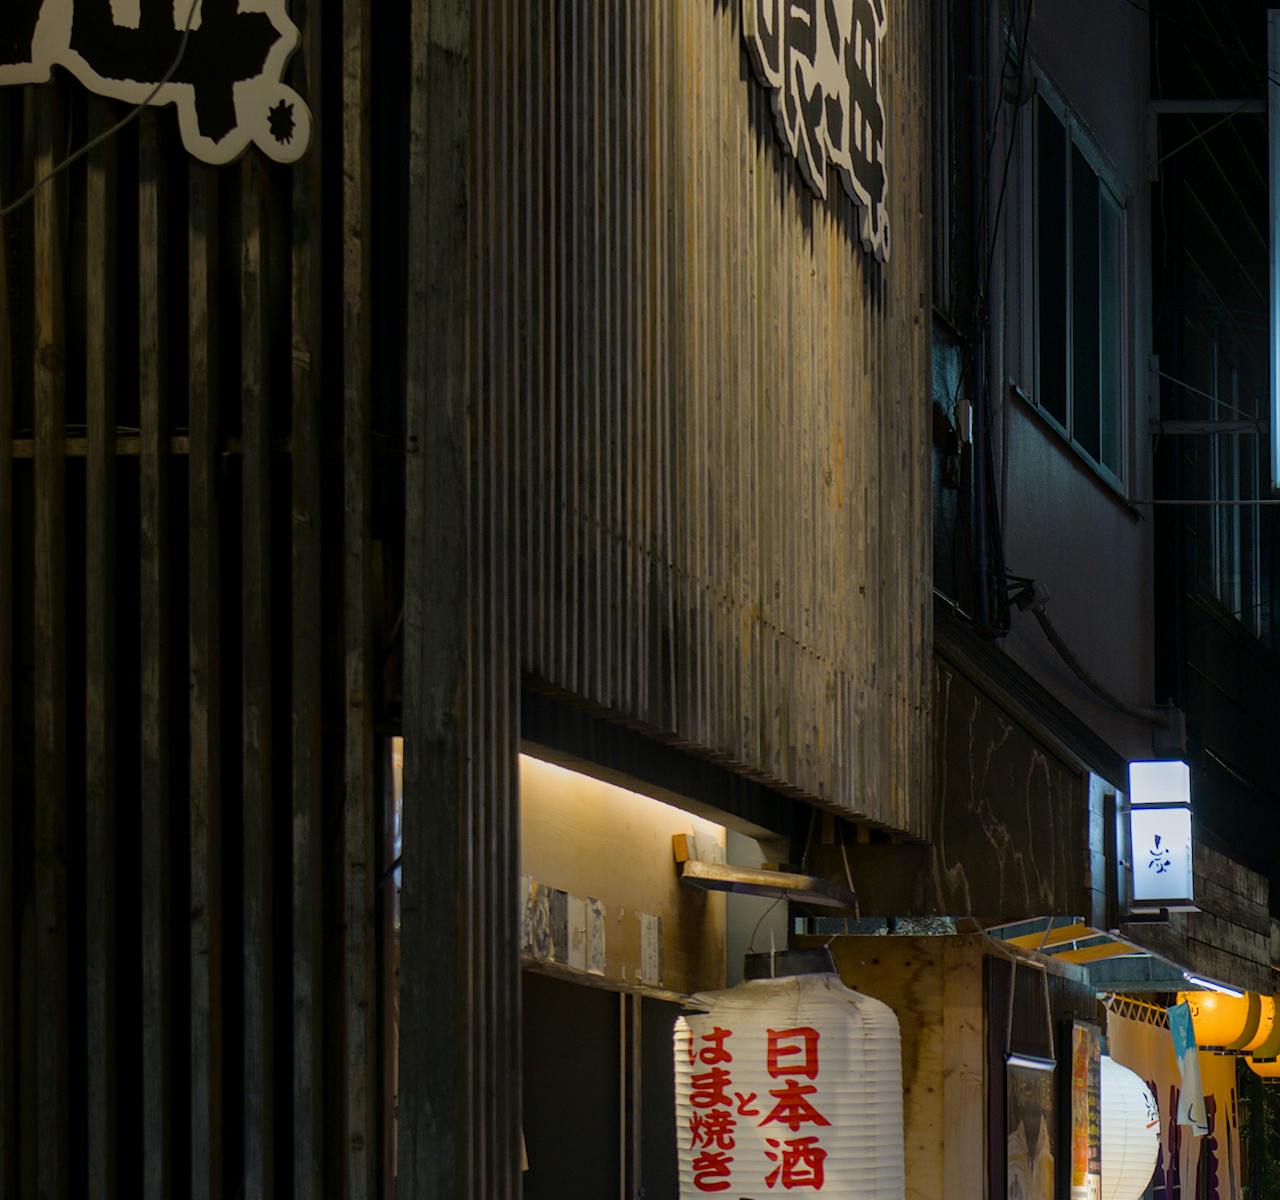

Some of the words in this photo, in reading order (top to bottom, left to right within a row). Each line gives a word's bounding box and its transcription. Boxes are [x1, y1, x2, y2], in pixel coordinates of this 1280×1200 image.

[690, 1026, 735, 1193] はま焼き
[736, 1091, 760, 1117] と
[759, 1028, 831, 1191] 日本酒
